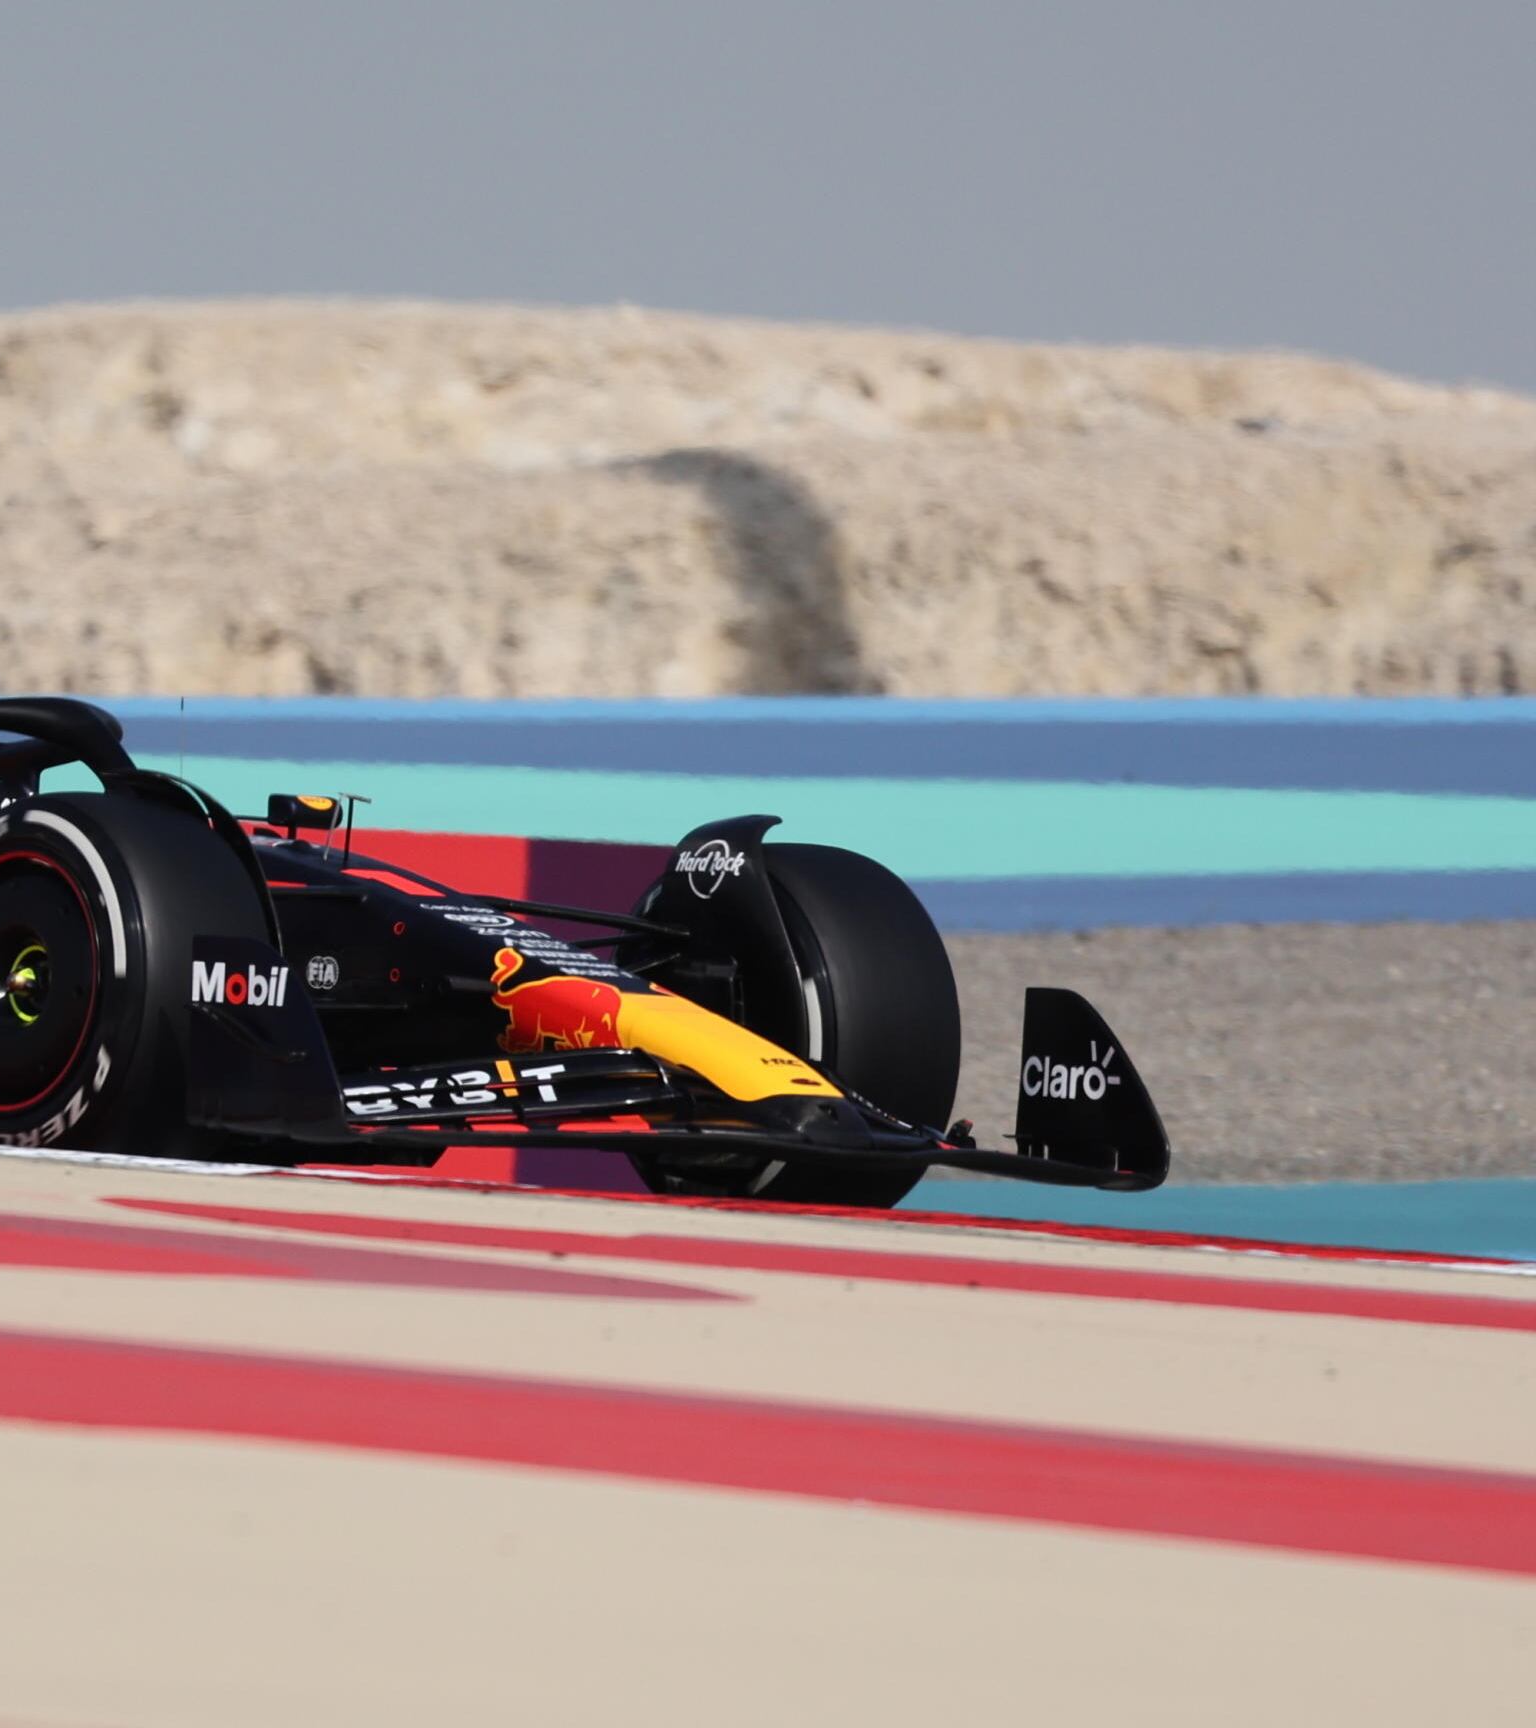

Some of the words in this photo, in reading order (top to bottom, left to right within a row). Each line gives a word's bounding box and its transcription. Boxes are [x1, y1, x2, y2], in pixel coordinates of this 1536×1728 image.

[675, 850, 714, 873] Hard
[192, 961, 288, 1007] Mobil
[307, 959, 337, 985] FIA
[343, 1060, 565, 1116] BYBIT
[1022, 1055, 1107, 1101] Claro
